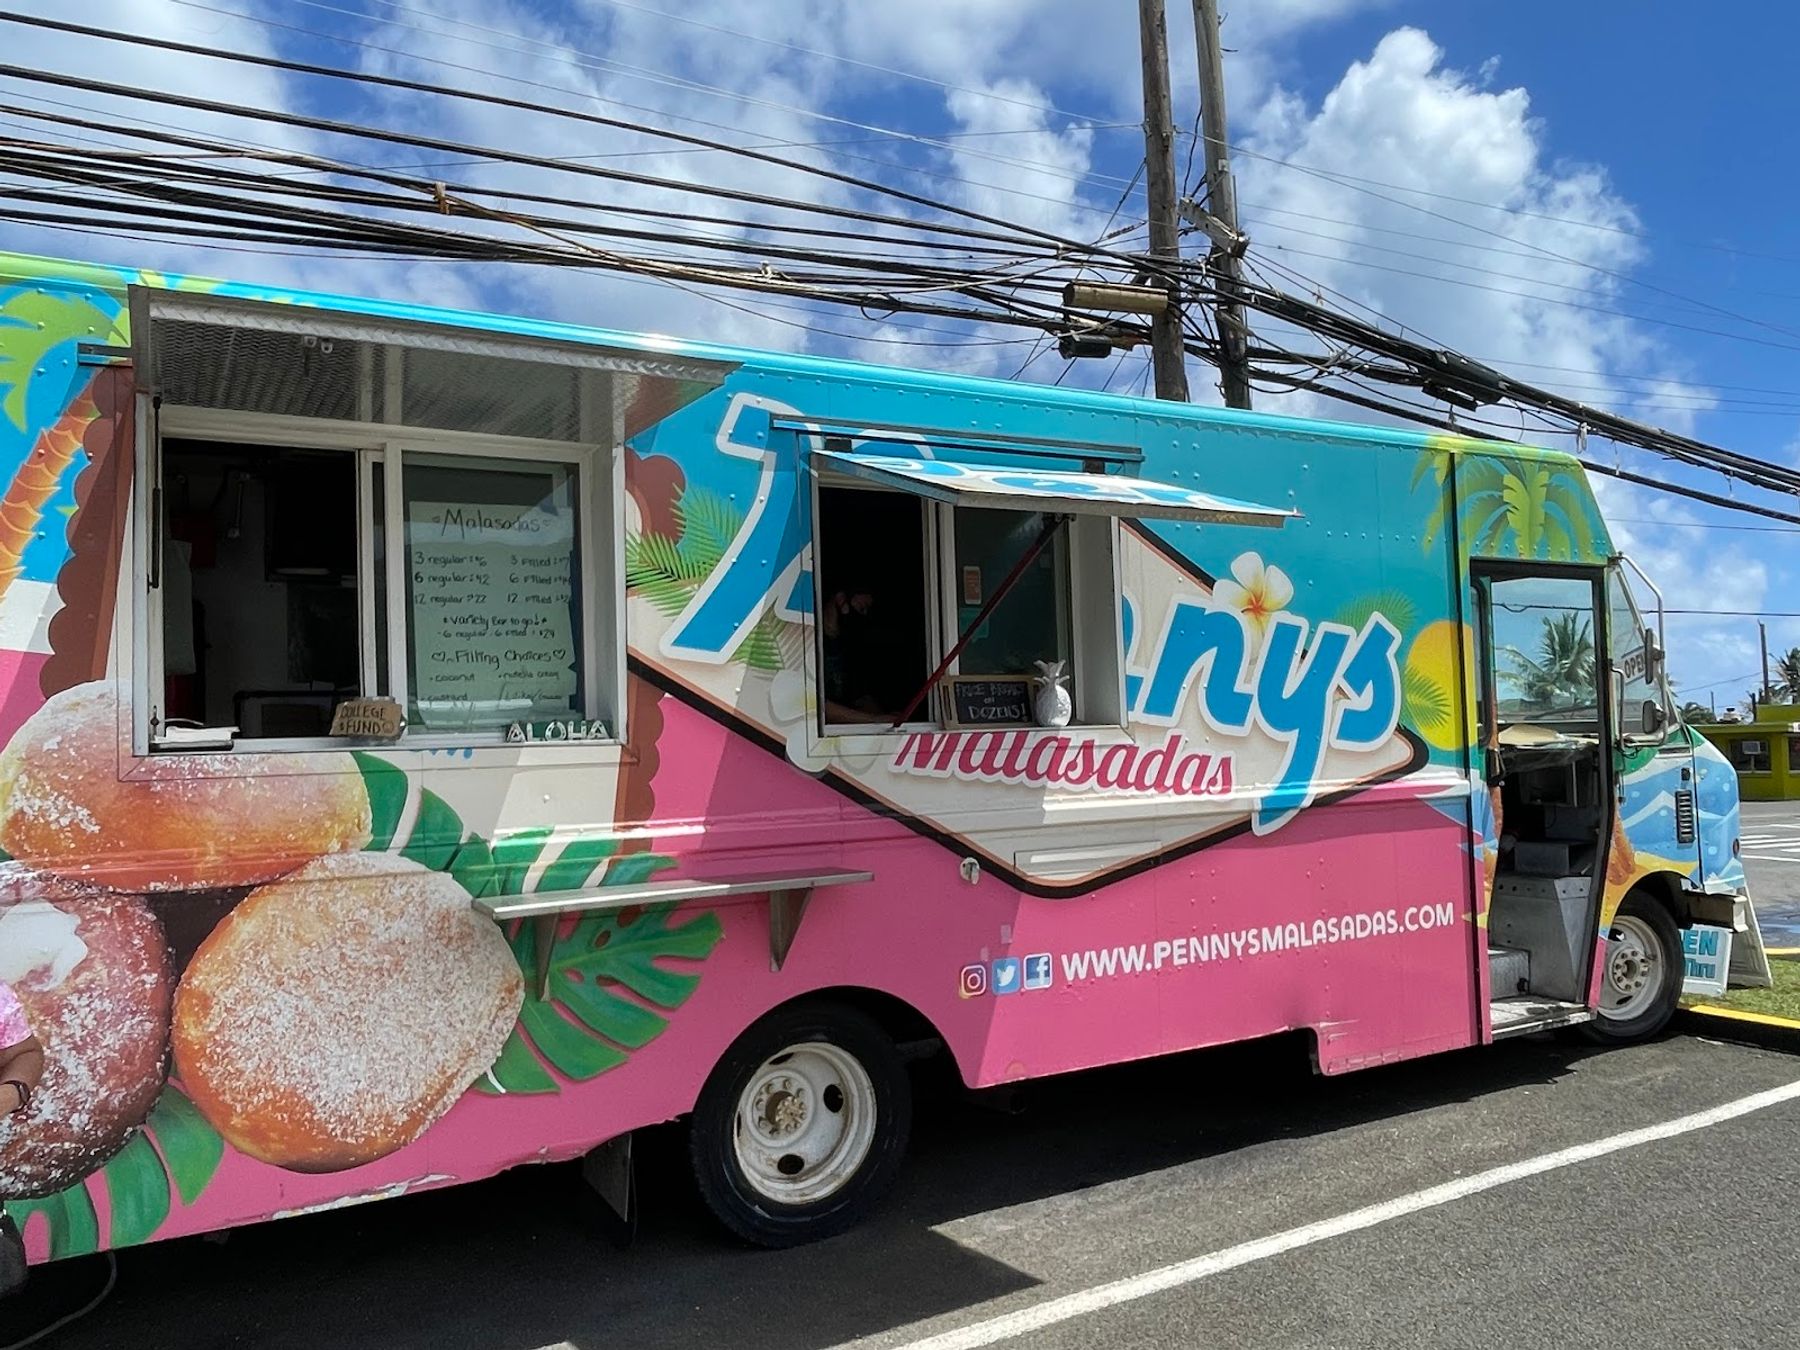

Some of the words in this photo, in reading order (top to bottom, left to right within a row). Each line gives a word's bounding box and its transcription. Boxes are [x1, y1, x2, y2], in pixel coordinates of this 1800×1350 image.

[441, 508, 541, 539] Malasadas
[414, 551, 425, 565] 3
[414, 571, 424, 584] 6
[414, 593, 427, 605] 12
[507, 592, 519, 604] 12
[507, 720, 610, 743] ALOHA
[894, 729, 1233, 796] Malasadas
[1061, 902, 1455, 981] WWW.PENNYSMALASADAS.COM
